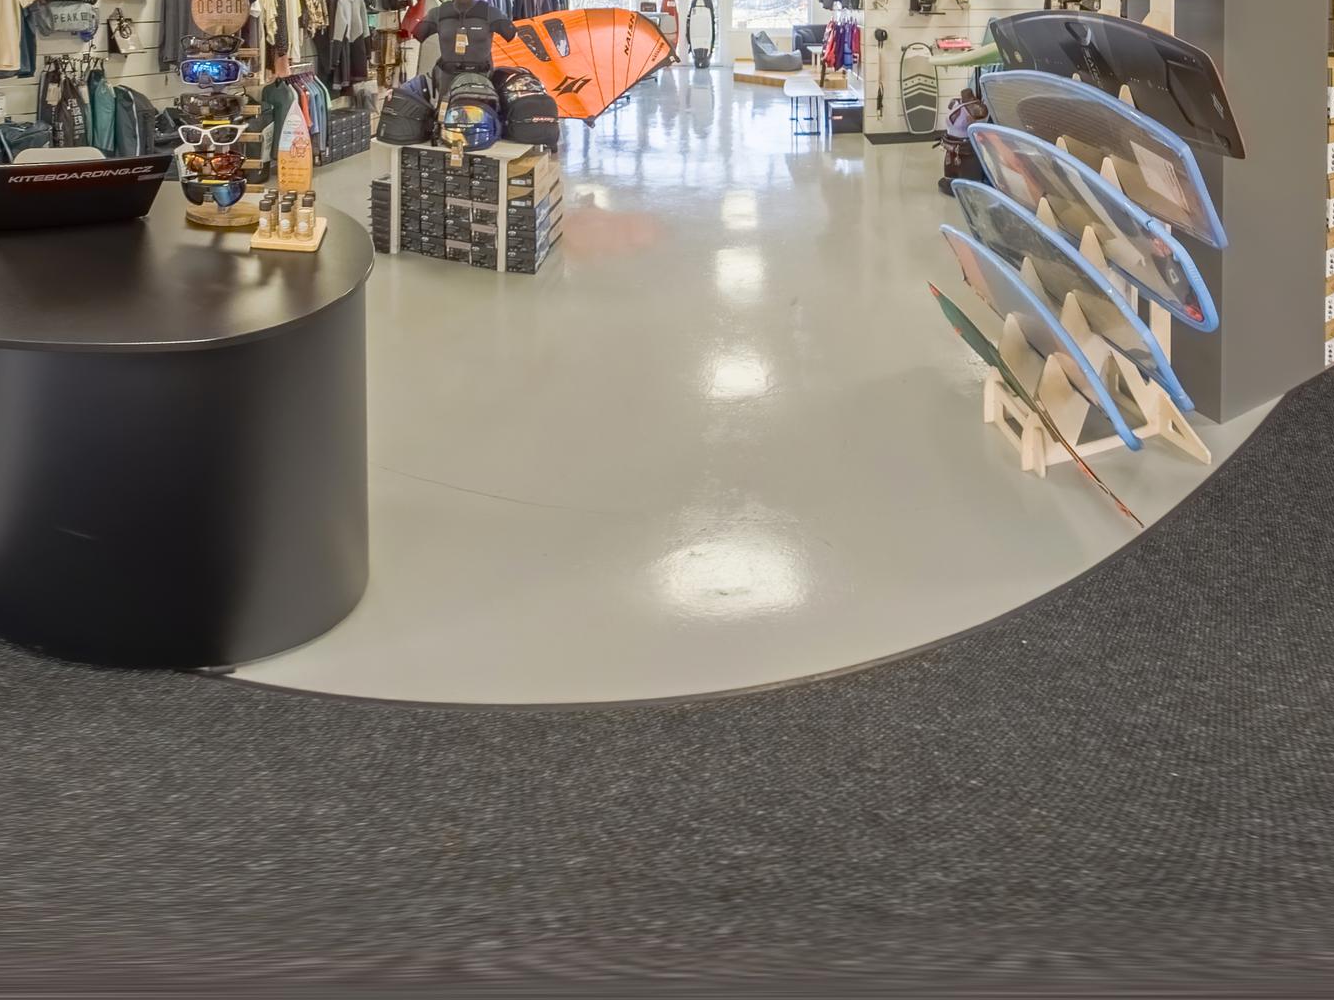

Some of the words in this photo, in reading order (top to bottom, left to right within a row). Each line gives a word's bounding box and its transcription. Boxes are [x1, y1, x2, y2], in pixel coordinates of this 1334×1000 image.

[197, 0, 243, 14] ocean
[53, 13, 79, 24] PEAK
[624, 14, 635, 56] NAISH
[8, 165, 154, 183] KITEBOARDING.CZ
